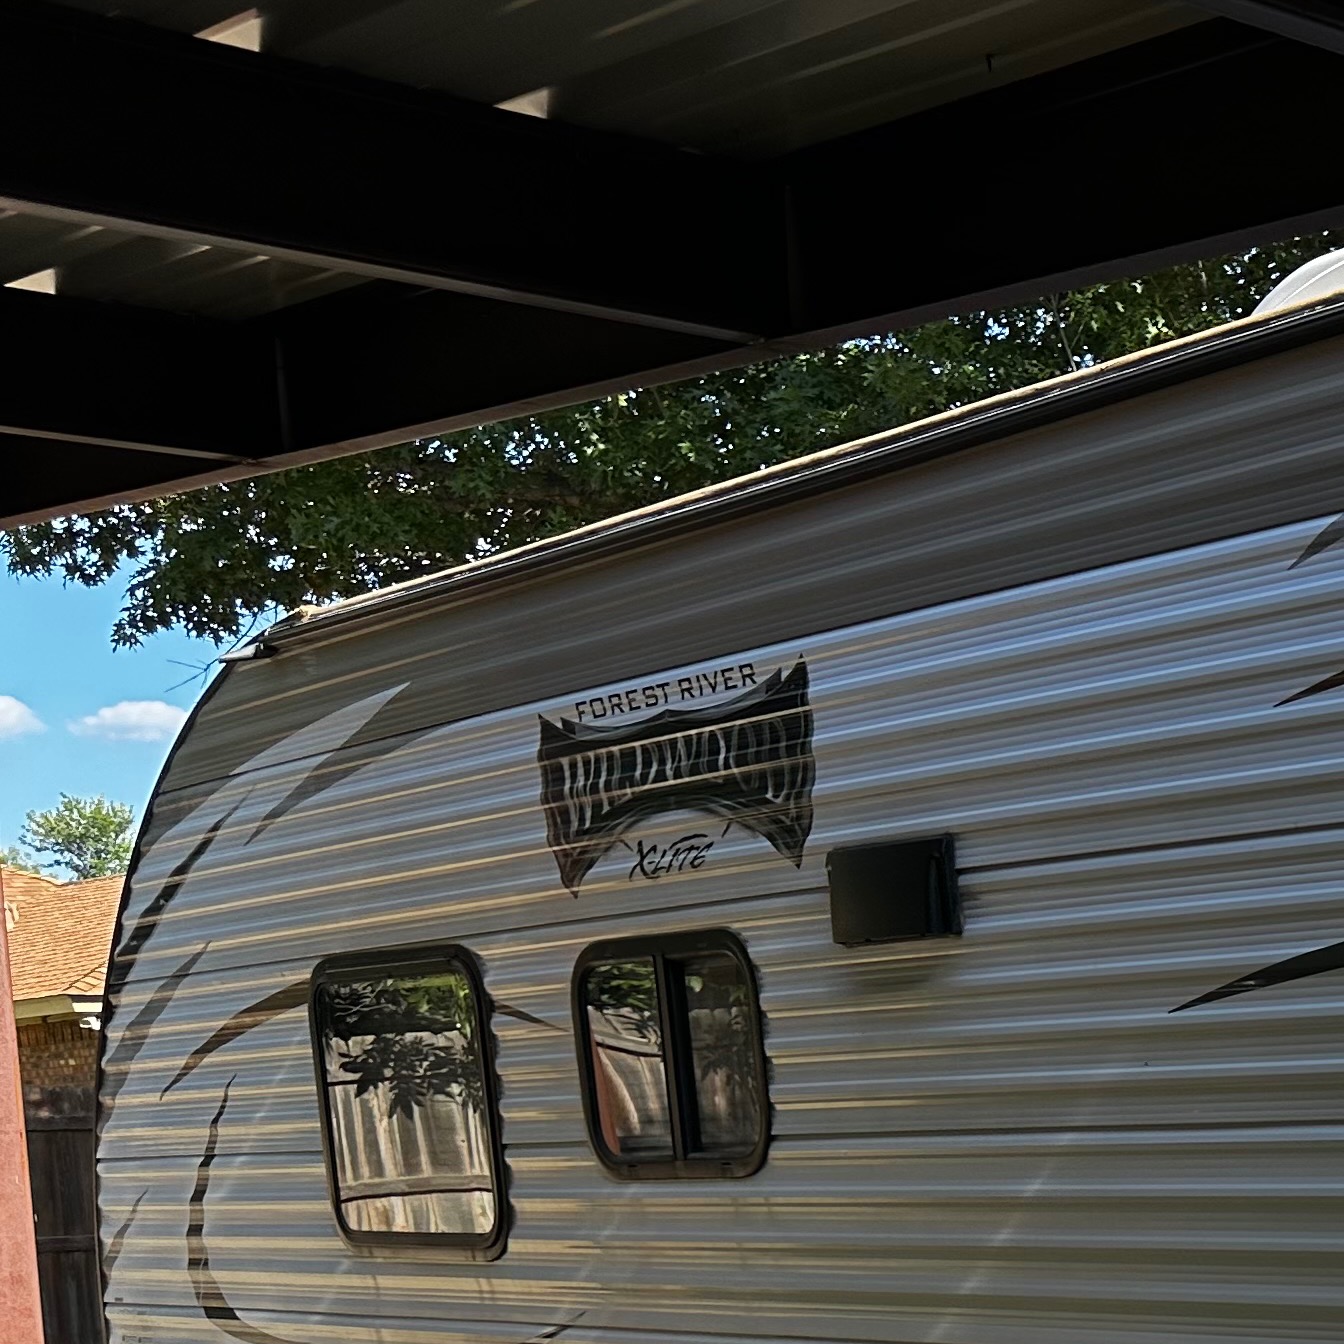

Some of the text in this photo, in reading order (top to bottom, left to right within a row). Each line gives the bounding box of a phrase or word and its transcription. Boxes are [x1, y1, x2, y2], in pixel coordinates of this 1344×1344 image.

[575, 663, 757, 722] FOREST RIVER
[559, 717, 788, 840] WILDWOOD
[629, 833, 714, 881] X-LITE
